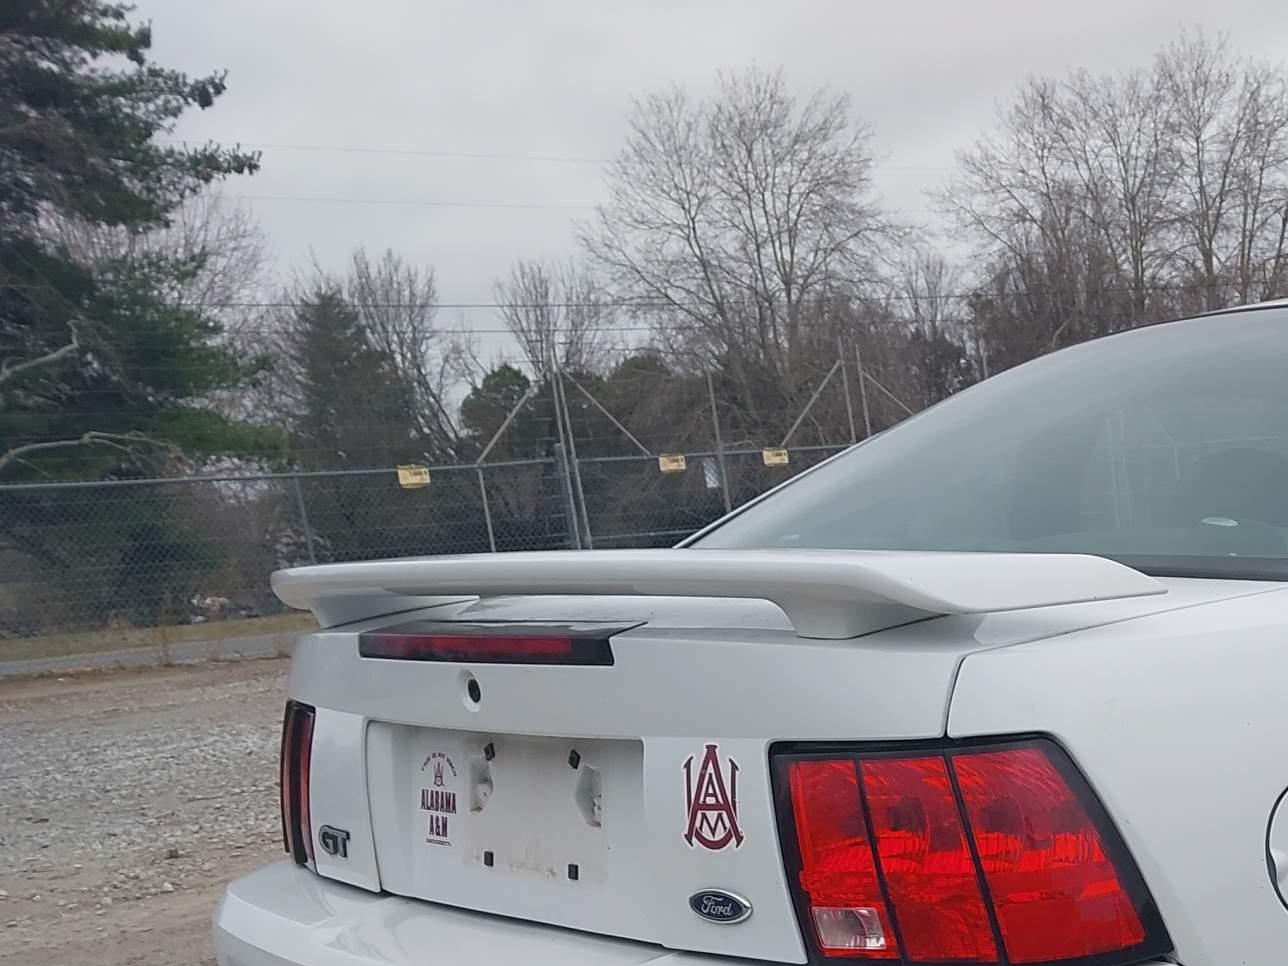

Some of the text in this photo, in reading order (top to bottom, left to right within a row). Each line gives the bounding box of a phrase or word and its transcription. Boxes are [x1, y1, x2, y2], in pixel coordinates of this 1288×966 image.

[421, 788, 457, 814] ALABAMA
[429, 814, 448, 837] A&M
[319, 824, 351, 858] GT
[701, 895, 734, 916] Ford
